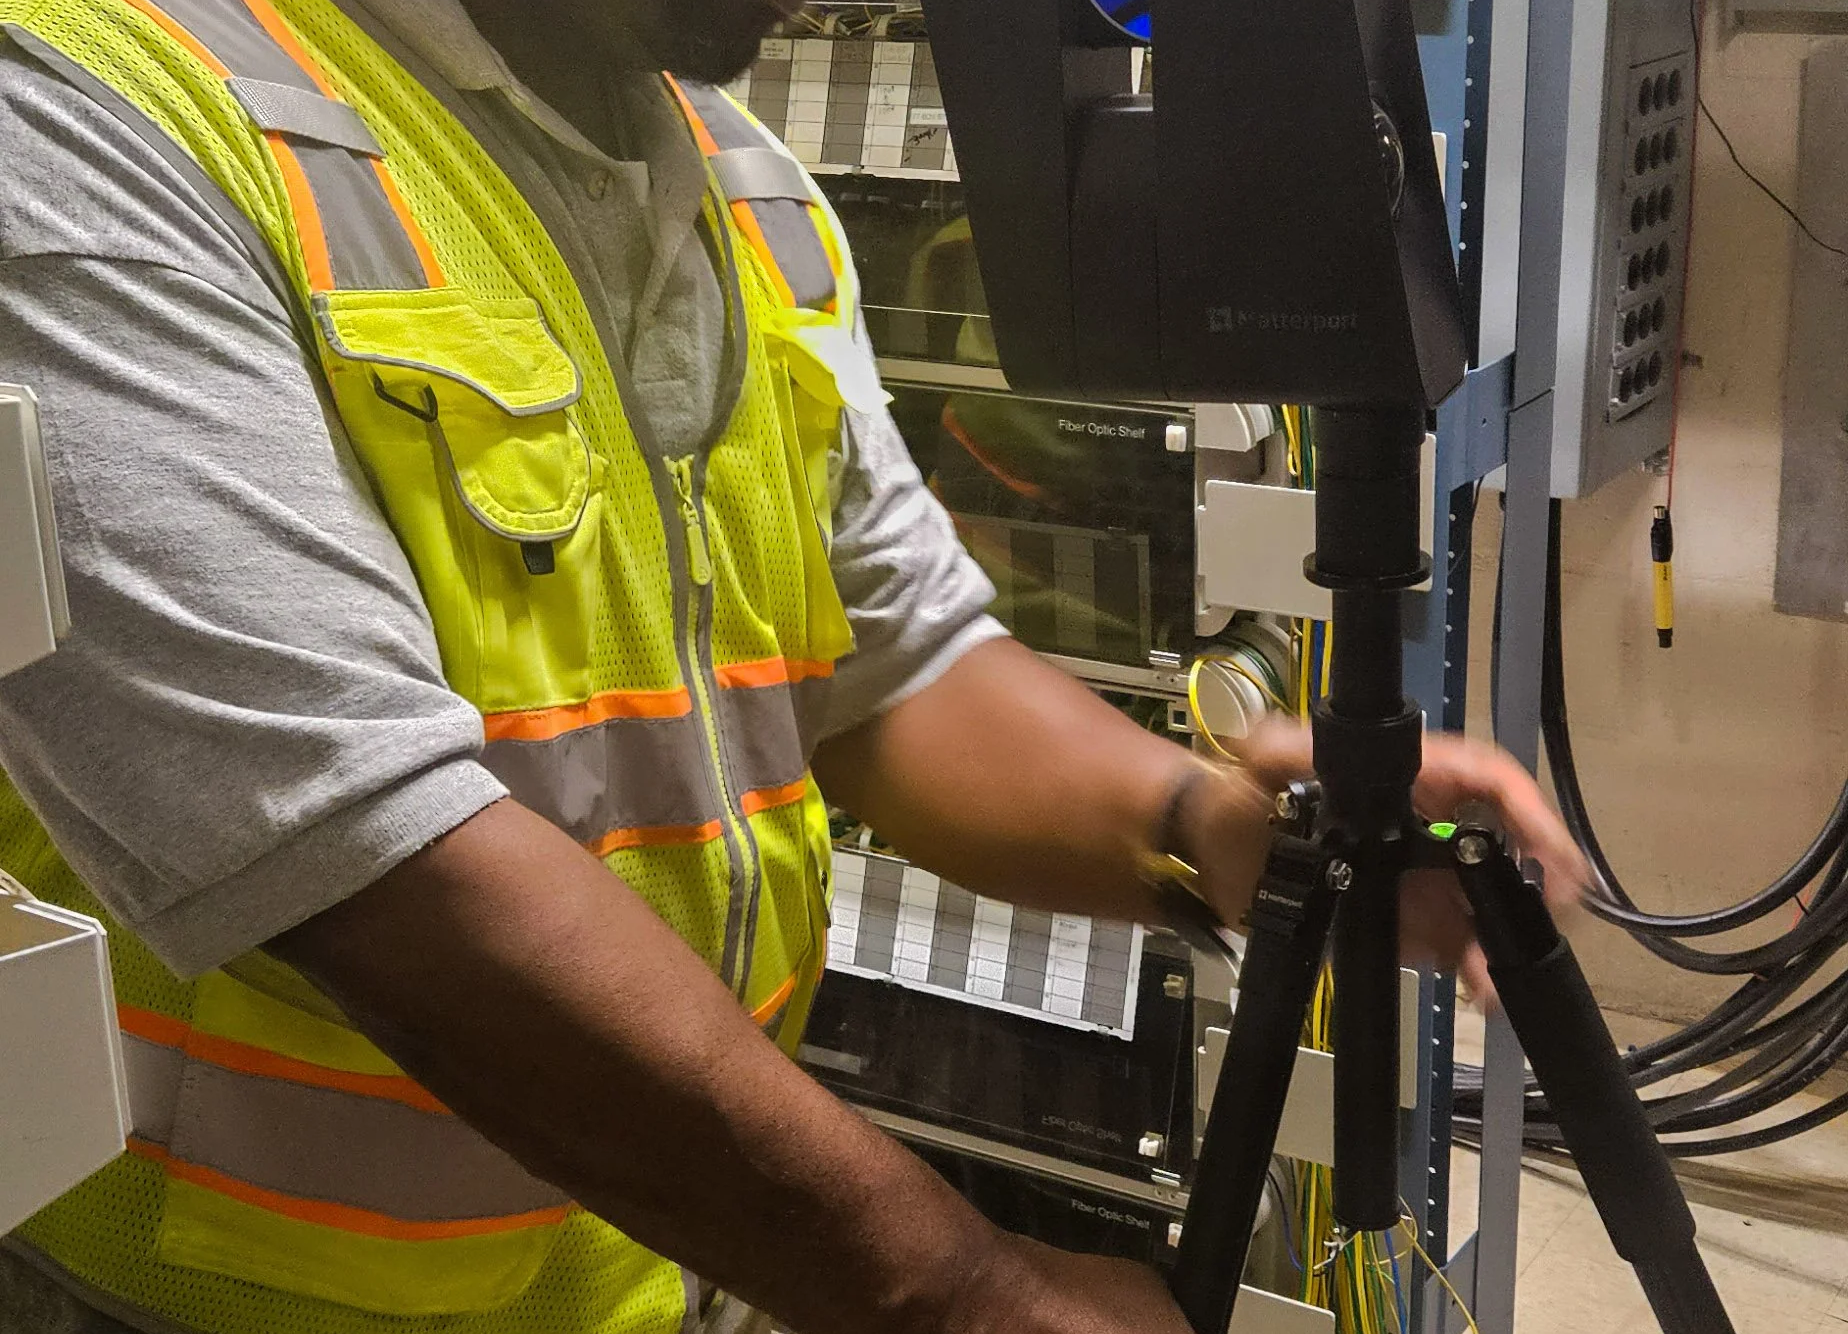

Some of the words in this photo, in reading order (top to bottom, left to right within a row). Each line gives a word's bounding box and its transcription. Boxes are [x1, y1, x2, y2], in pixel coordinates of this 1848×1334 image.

[1059, 419, 1085, 432] Fiber
[1088, 422, 1116, 436] Optic
[1119, 425, 1146, 439] Shelf
